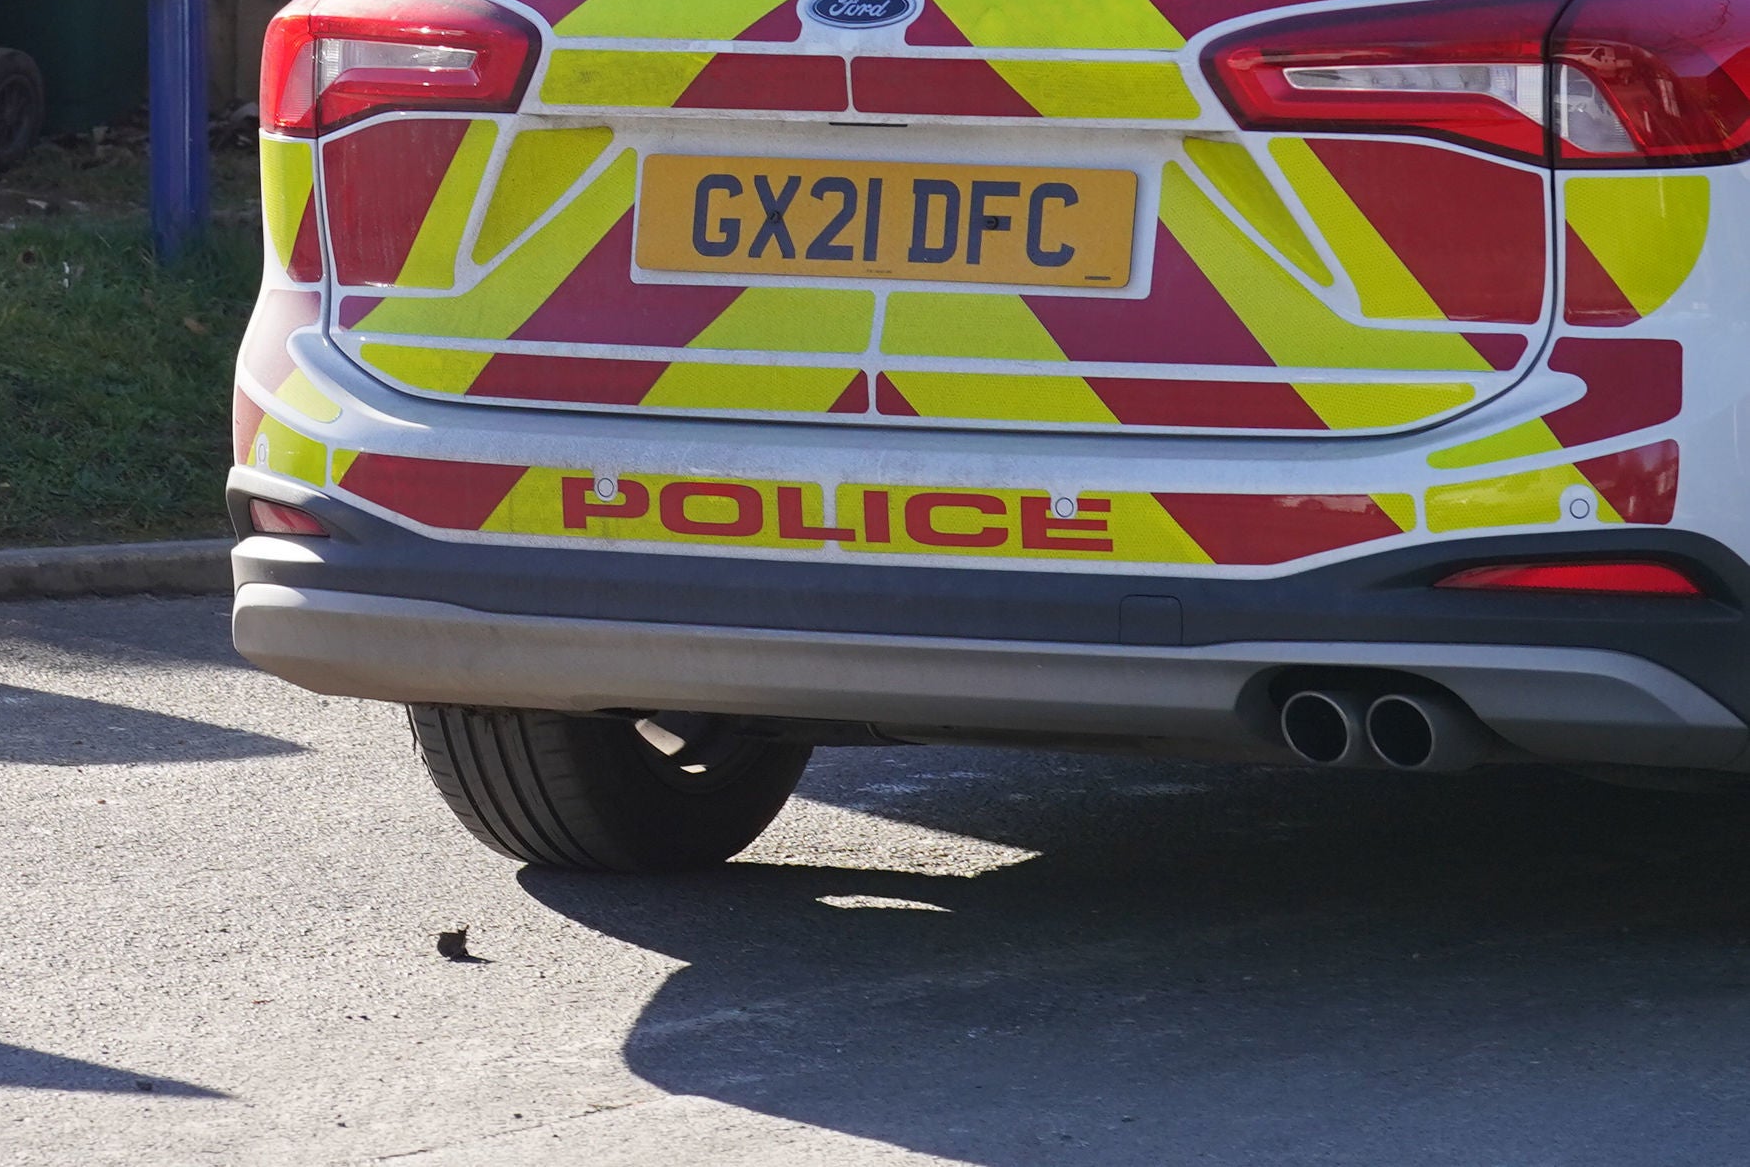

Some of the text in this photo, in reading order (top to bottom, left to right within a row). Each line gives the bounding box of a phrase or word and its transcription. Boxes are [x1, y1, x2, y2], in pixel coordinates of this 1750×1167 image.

[691, 172, 1079, 268] GX21 DFC
[561, 475, 1114, 553] POLICE
